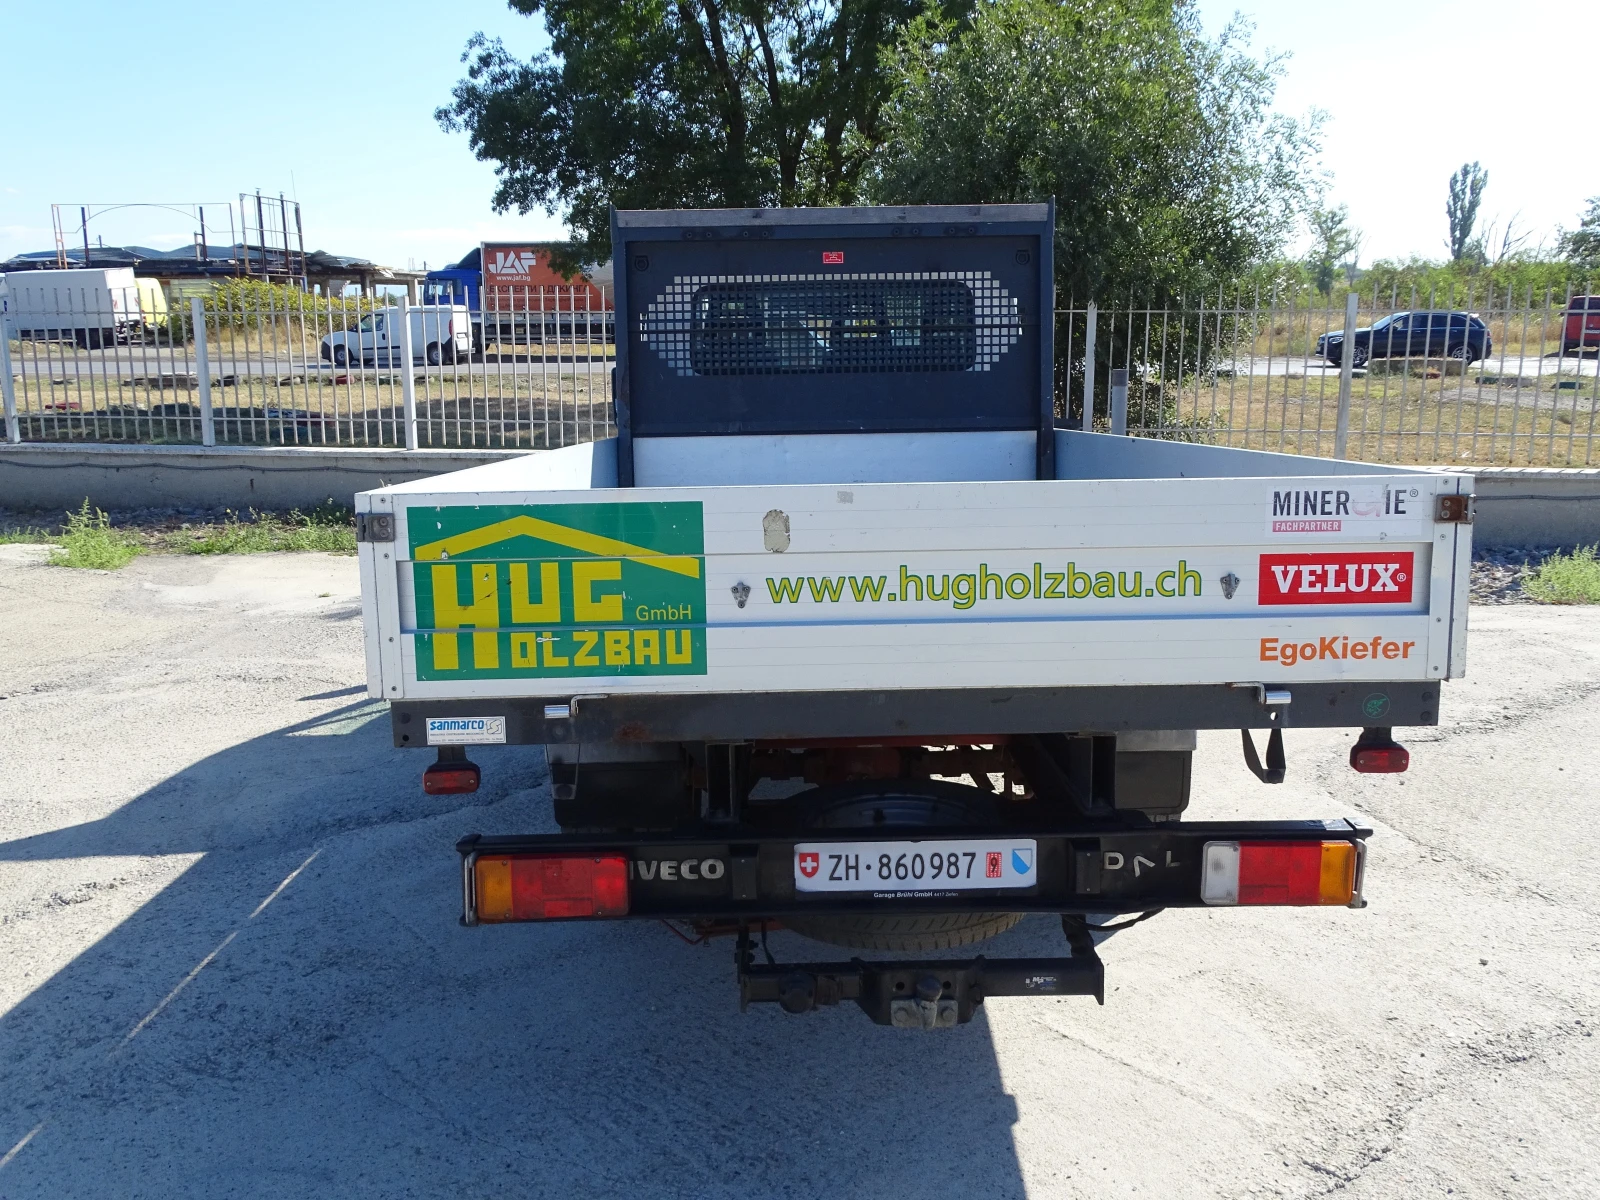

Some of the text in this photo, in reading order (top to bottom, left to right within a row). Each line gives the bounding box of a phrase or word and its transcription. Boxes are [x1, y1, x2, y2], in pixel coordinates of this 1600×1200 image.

[488, 251, 536, 274] JAF
[1275, 521, 1340, 532] FACHPARTNER
[765, 560, 1202, 610] www.hugholzbau.ch
[431, 561, 692, 670] HUG GmbH
[1259, 635, 1416, 667] EgoKiefer
[429, 719, 485, 731] sanmarco
